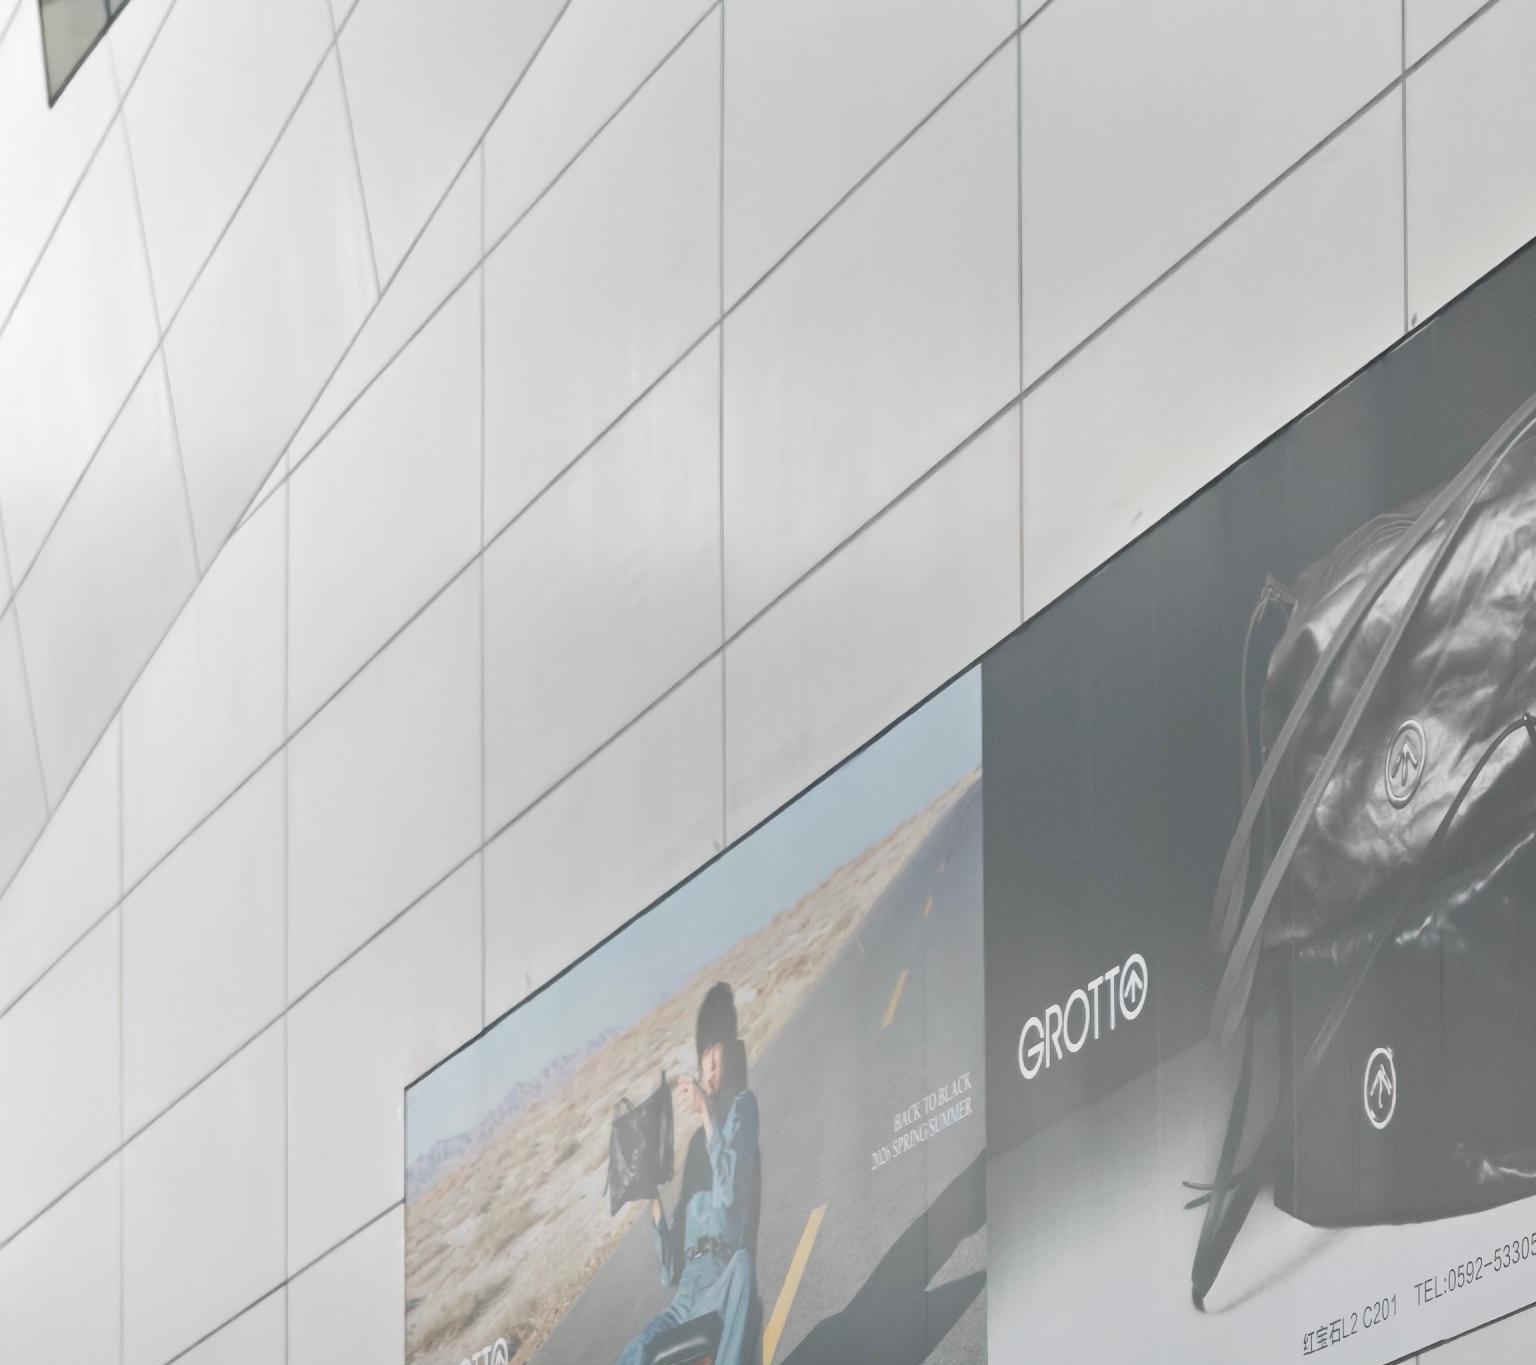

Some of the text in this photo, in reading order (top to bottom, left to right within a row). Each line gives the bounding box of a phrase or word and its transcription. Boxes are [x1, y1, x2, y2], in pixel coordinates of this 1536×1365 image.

[1018, 953, 1149, 1080] GROTTO
[1303, 1312, 1358, 1356] 红宝石L2
[1362, 1294, 1398, 1328] C201
